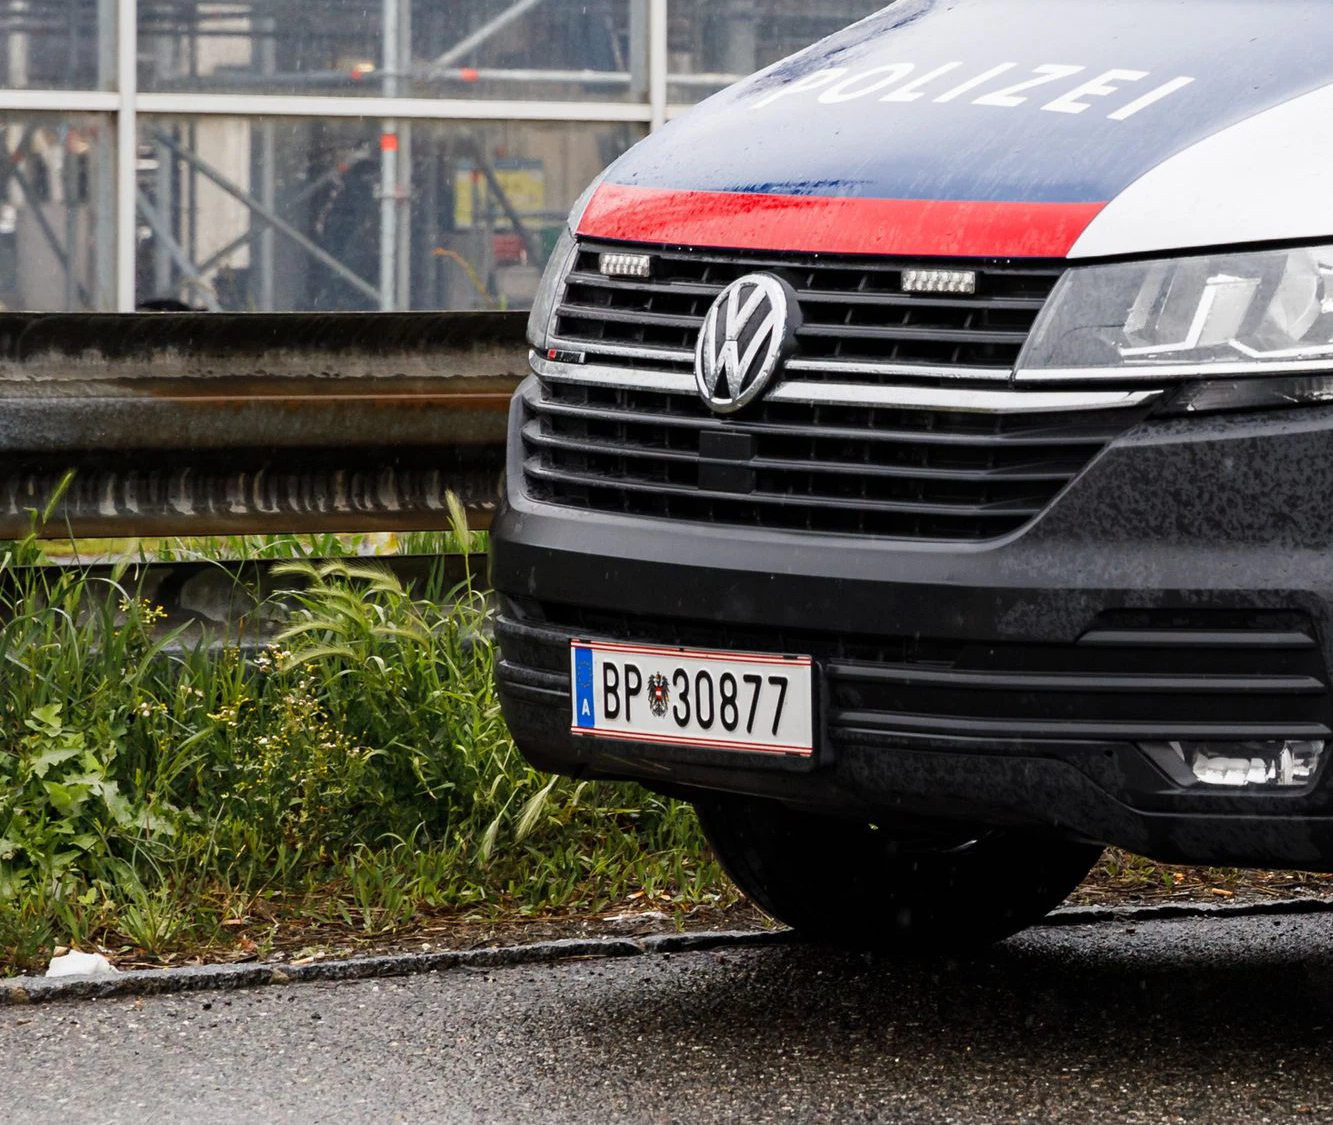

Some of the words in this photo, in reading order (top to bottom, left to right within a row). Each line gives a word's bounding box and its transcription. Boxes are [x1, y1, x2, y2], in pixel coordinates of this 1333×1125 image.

[750, 61, 1196, 121] POLIZEI
[581, 698, 592, 717] A
[603, 662, 642, 722] BP
[672, 668, 788, 736] 30877
